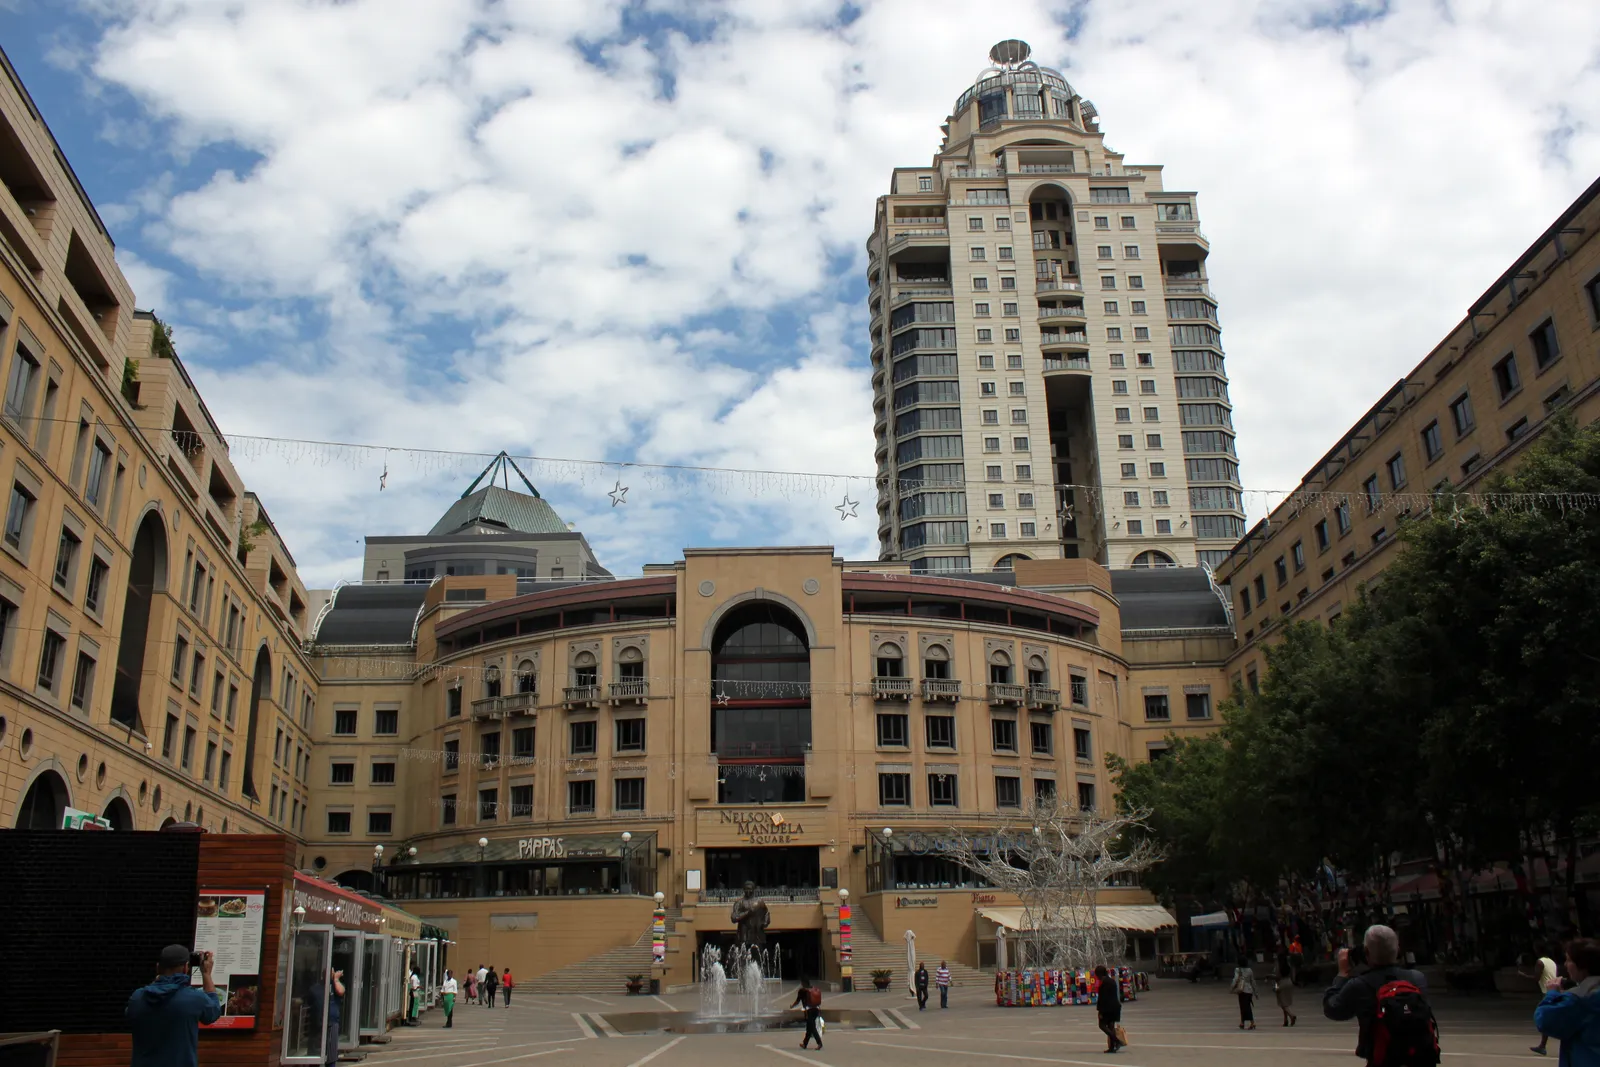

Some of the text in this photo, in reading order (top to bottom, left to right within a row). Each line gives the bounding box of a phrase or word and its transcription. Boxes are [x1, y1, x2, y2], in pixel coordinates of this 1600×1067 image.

[720, 810, 774, 824] NELSON
[737, 822, 804, 835] MANDELA
[750, 835, 791, 844] SQUARE
[518, 837, 564, 860] PAPPAS
[336, 898, 363, 926] STEAKHOUSE
